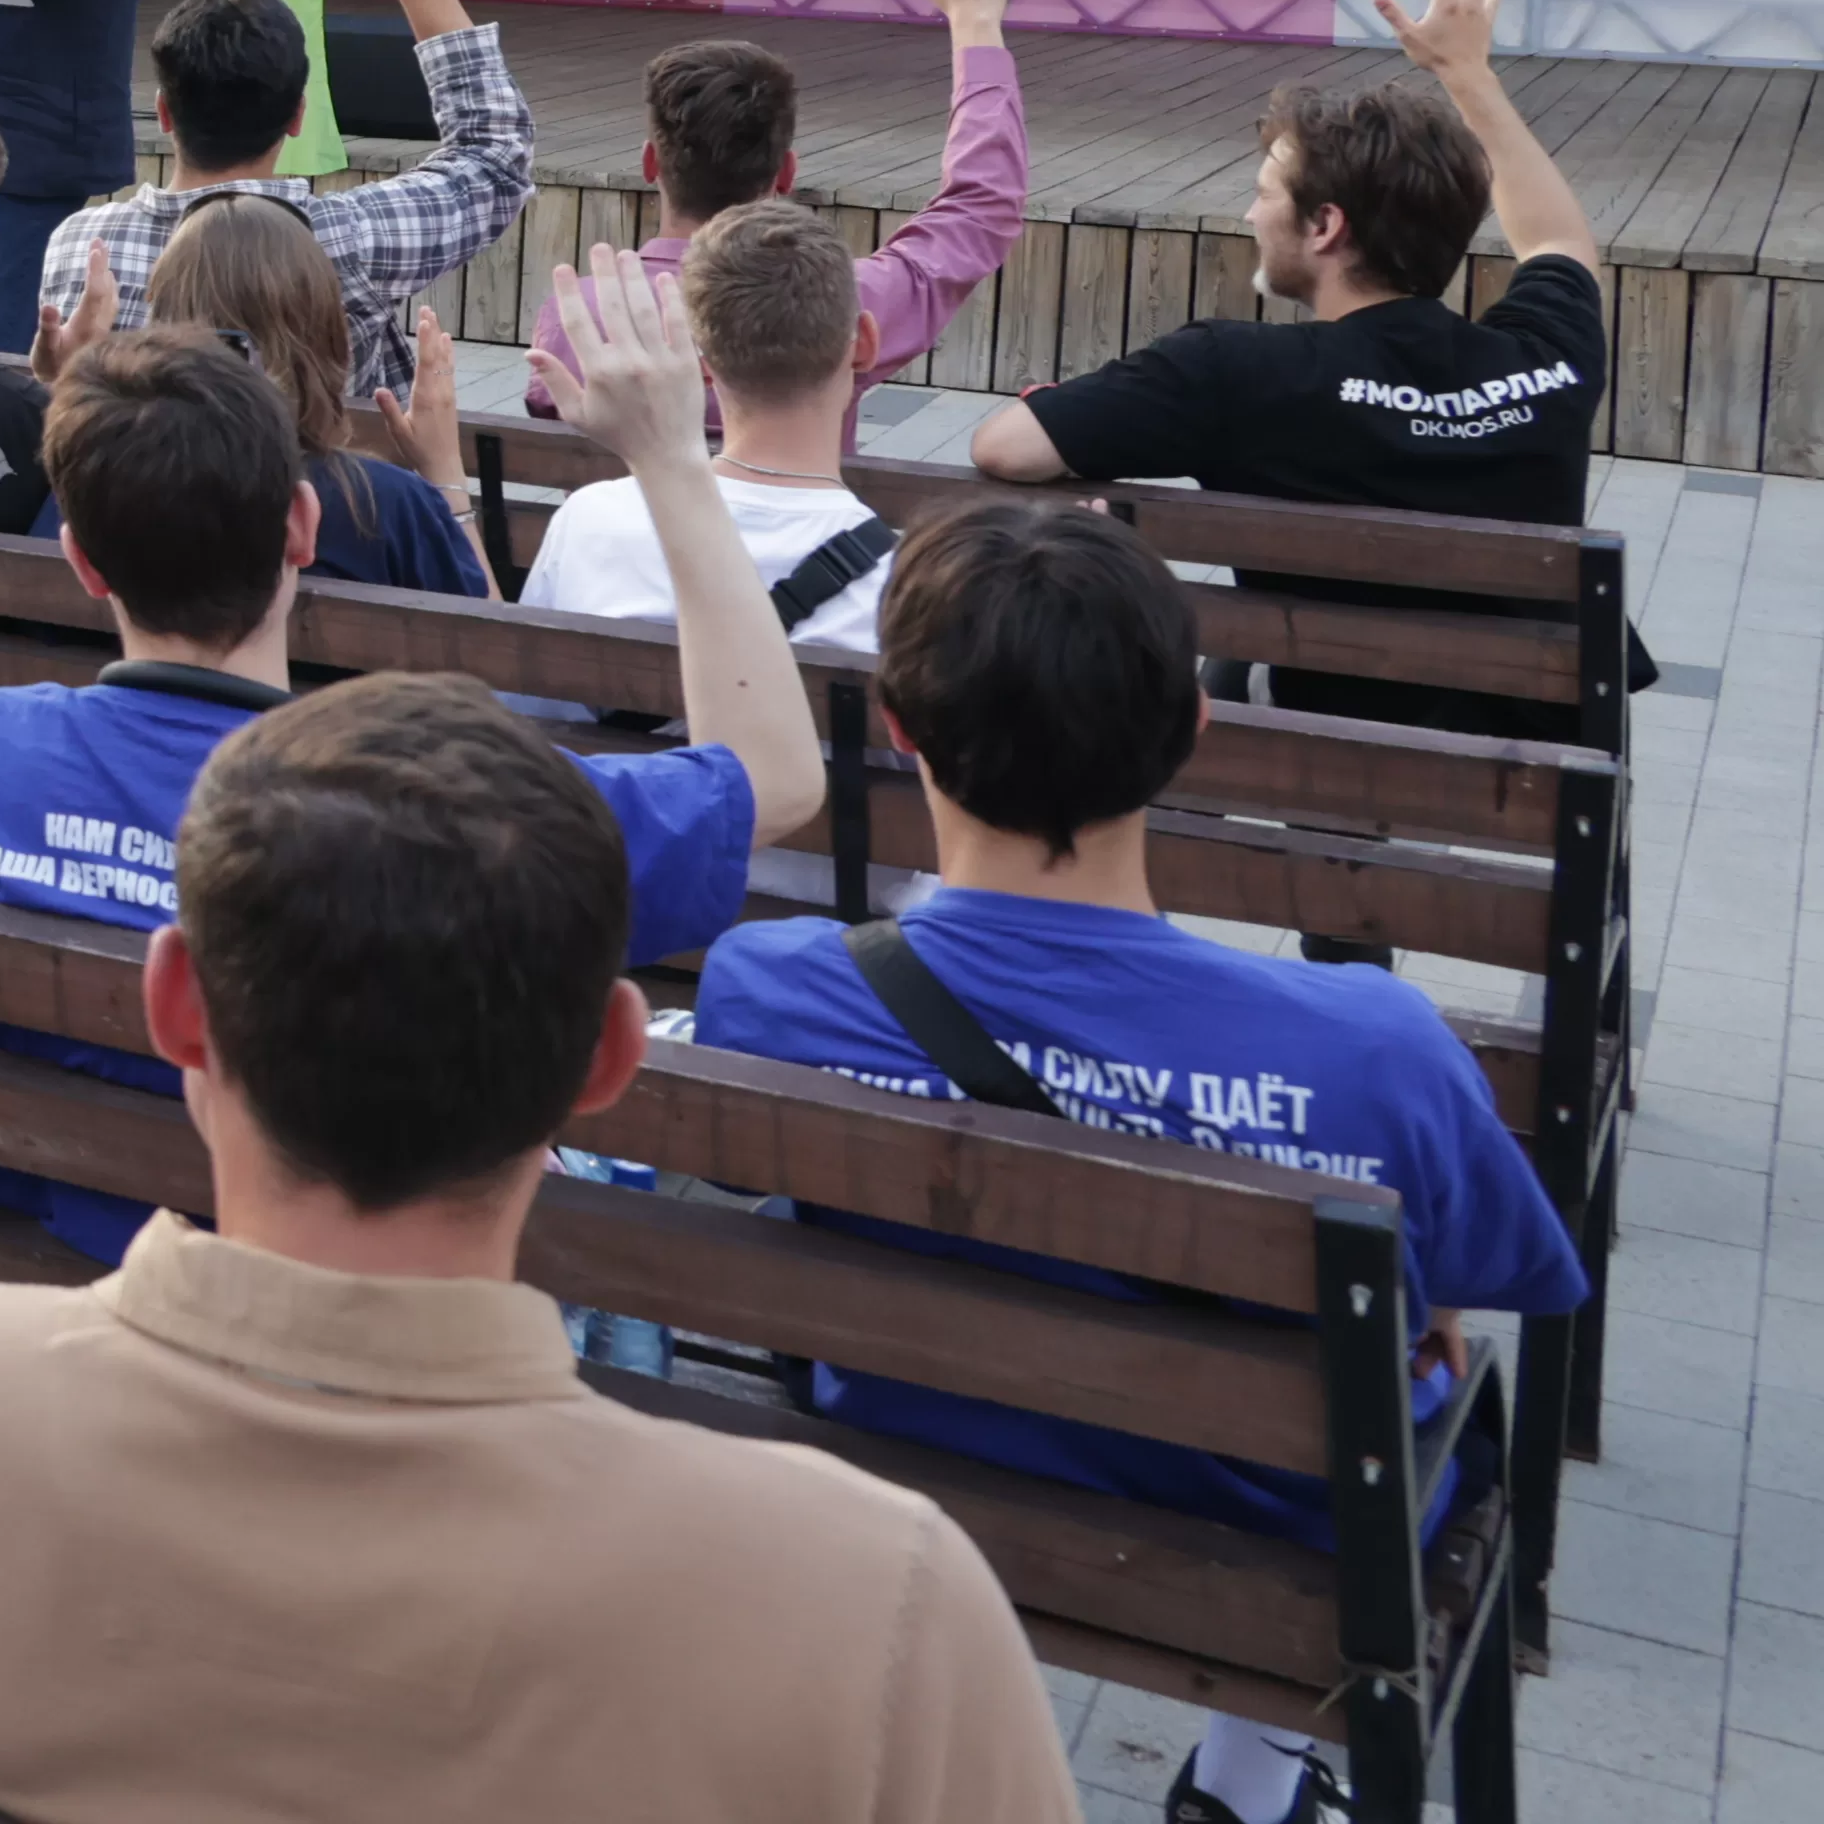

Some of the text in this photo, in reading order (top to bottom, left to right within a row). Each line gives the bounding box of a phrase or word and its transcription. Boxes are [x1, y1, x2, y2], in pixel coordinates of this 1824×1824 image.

[1410, 404, 1534, 439] DK.MOS.RU
[44, 812, 117, 857] НАМ
[59, 858, 180, 912] ВЕРНОС
[1043, 1045, 1173, 1108] СИЛУ
[1186, 1071, 1315, 1136] ДАЁТ
